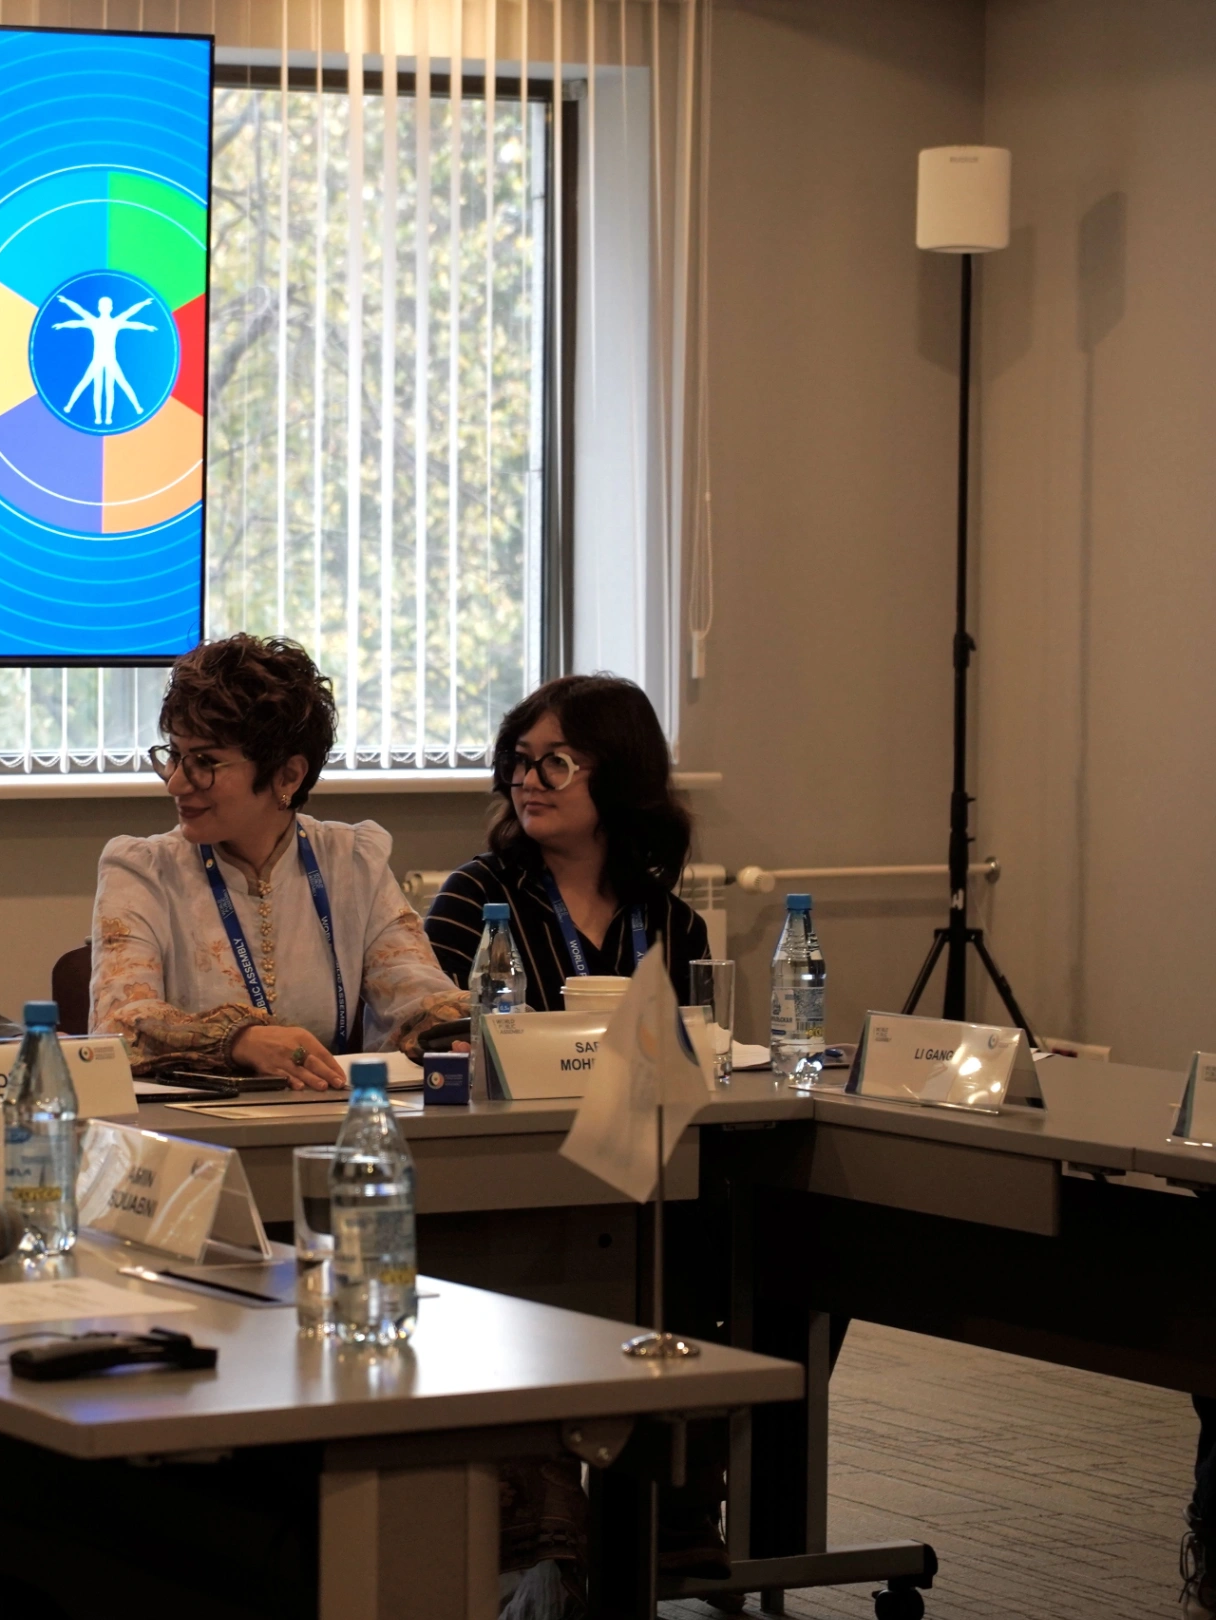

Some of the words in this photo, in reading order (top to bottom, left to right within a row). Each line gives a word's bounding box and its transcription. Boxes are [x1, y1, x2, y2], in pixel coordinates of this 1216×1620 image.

[233, 938, 258, 985] ASSEMBLY
[569, 939, 585, 971] WORLD
[251, 986, 267, 1010] BLIC
[560, 1058, 595, 1071] MOH
[914, 1048, 924, 1060] LI
[925, 1049, 955, 1062] GANG
